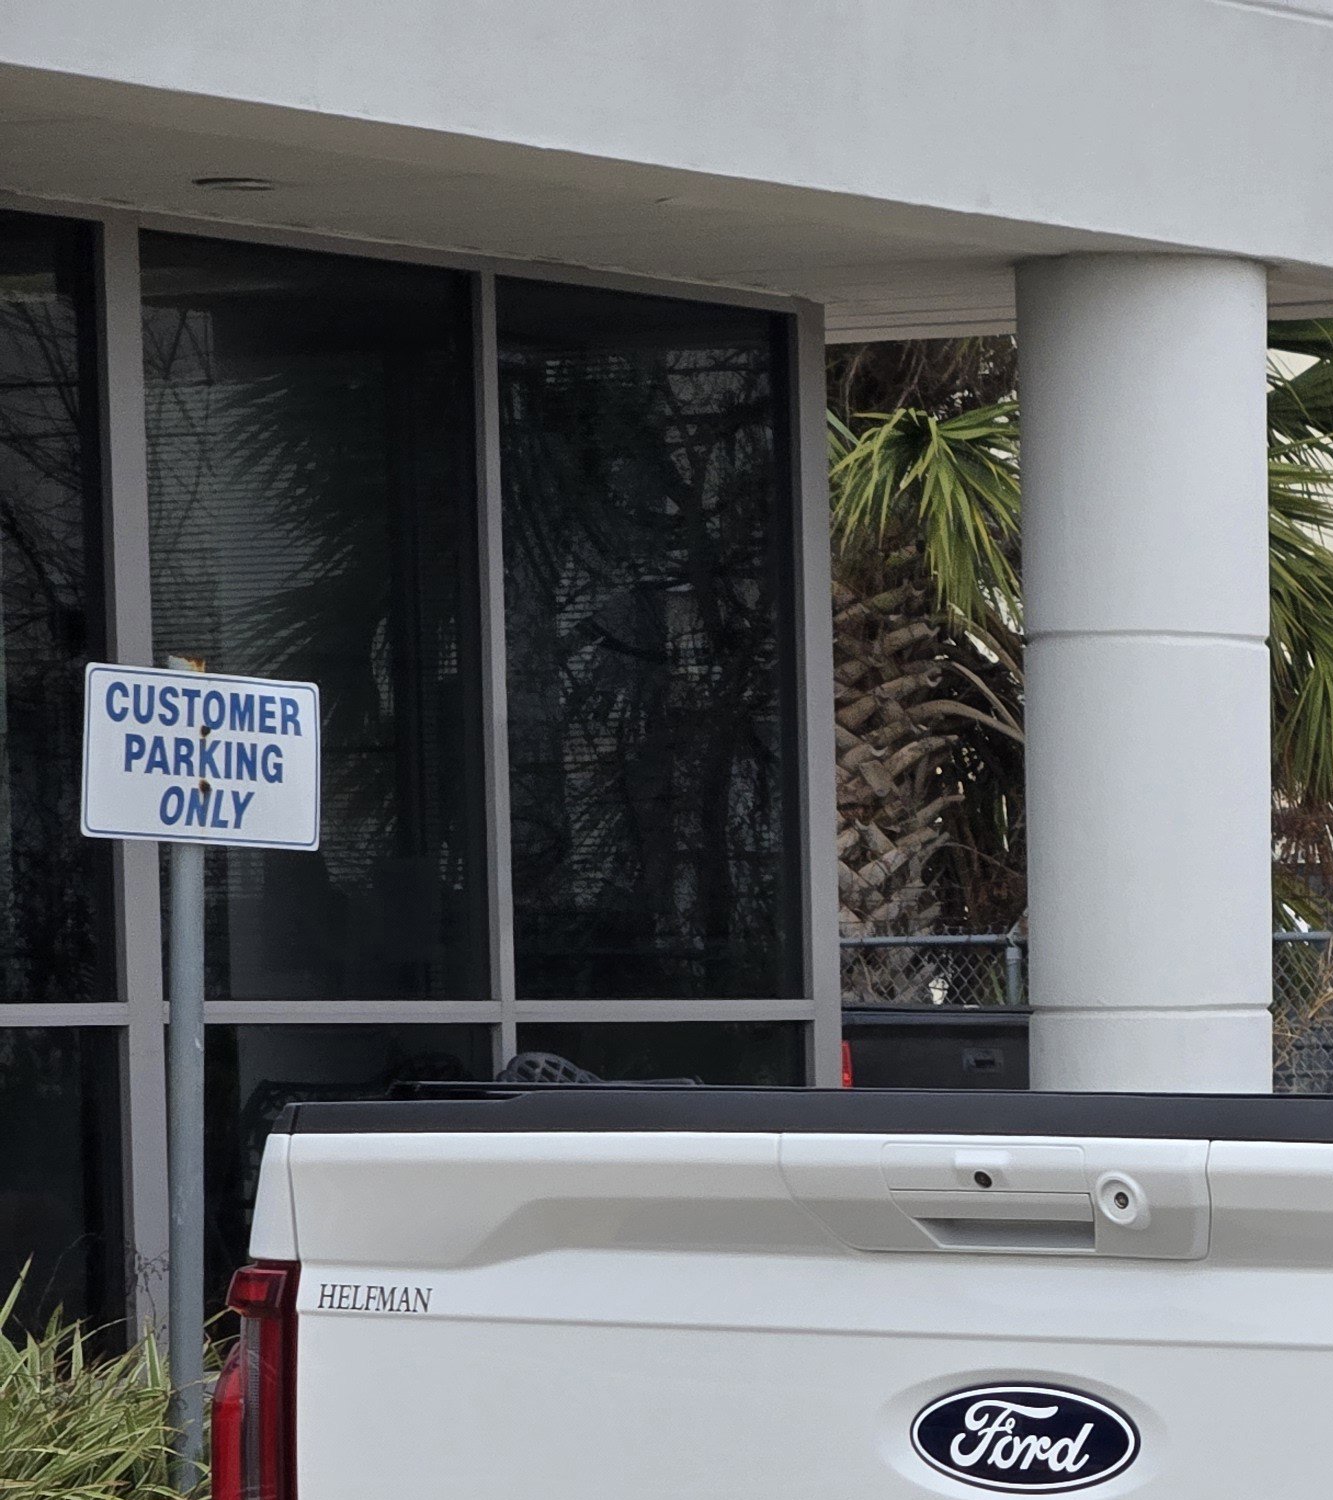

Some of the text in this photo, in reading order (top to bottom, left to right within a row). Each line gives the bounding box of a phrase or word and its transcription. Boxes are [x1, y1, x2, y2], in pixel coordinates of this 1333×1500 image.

[105, 682, 302, 736] CUSTOMER
[124, 733, 284, 784] PARKING
[159, 786, 255, 829] ONLY
[317, 1283, 433, 1313] HELFMAN
[951, 1400, 1094, 1472] Ford
